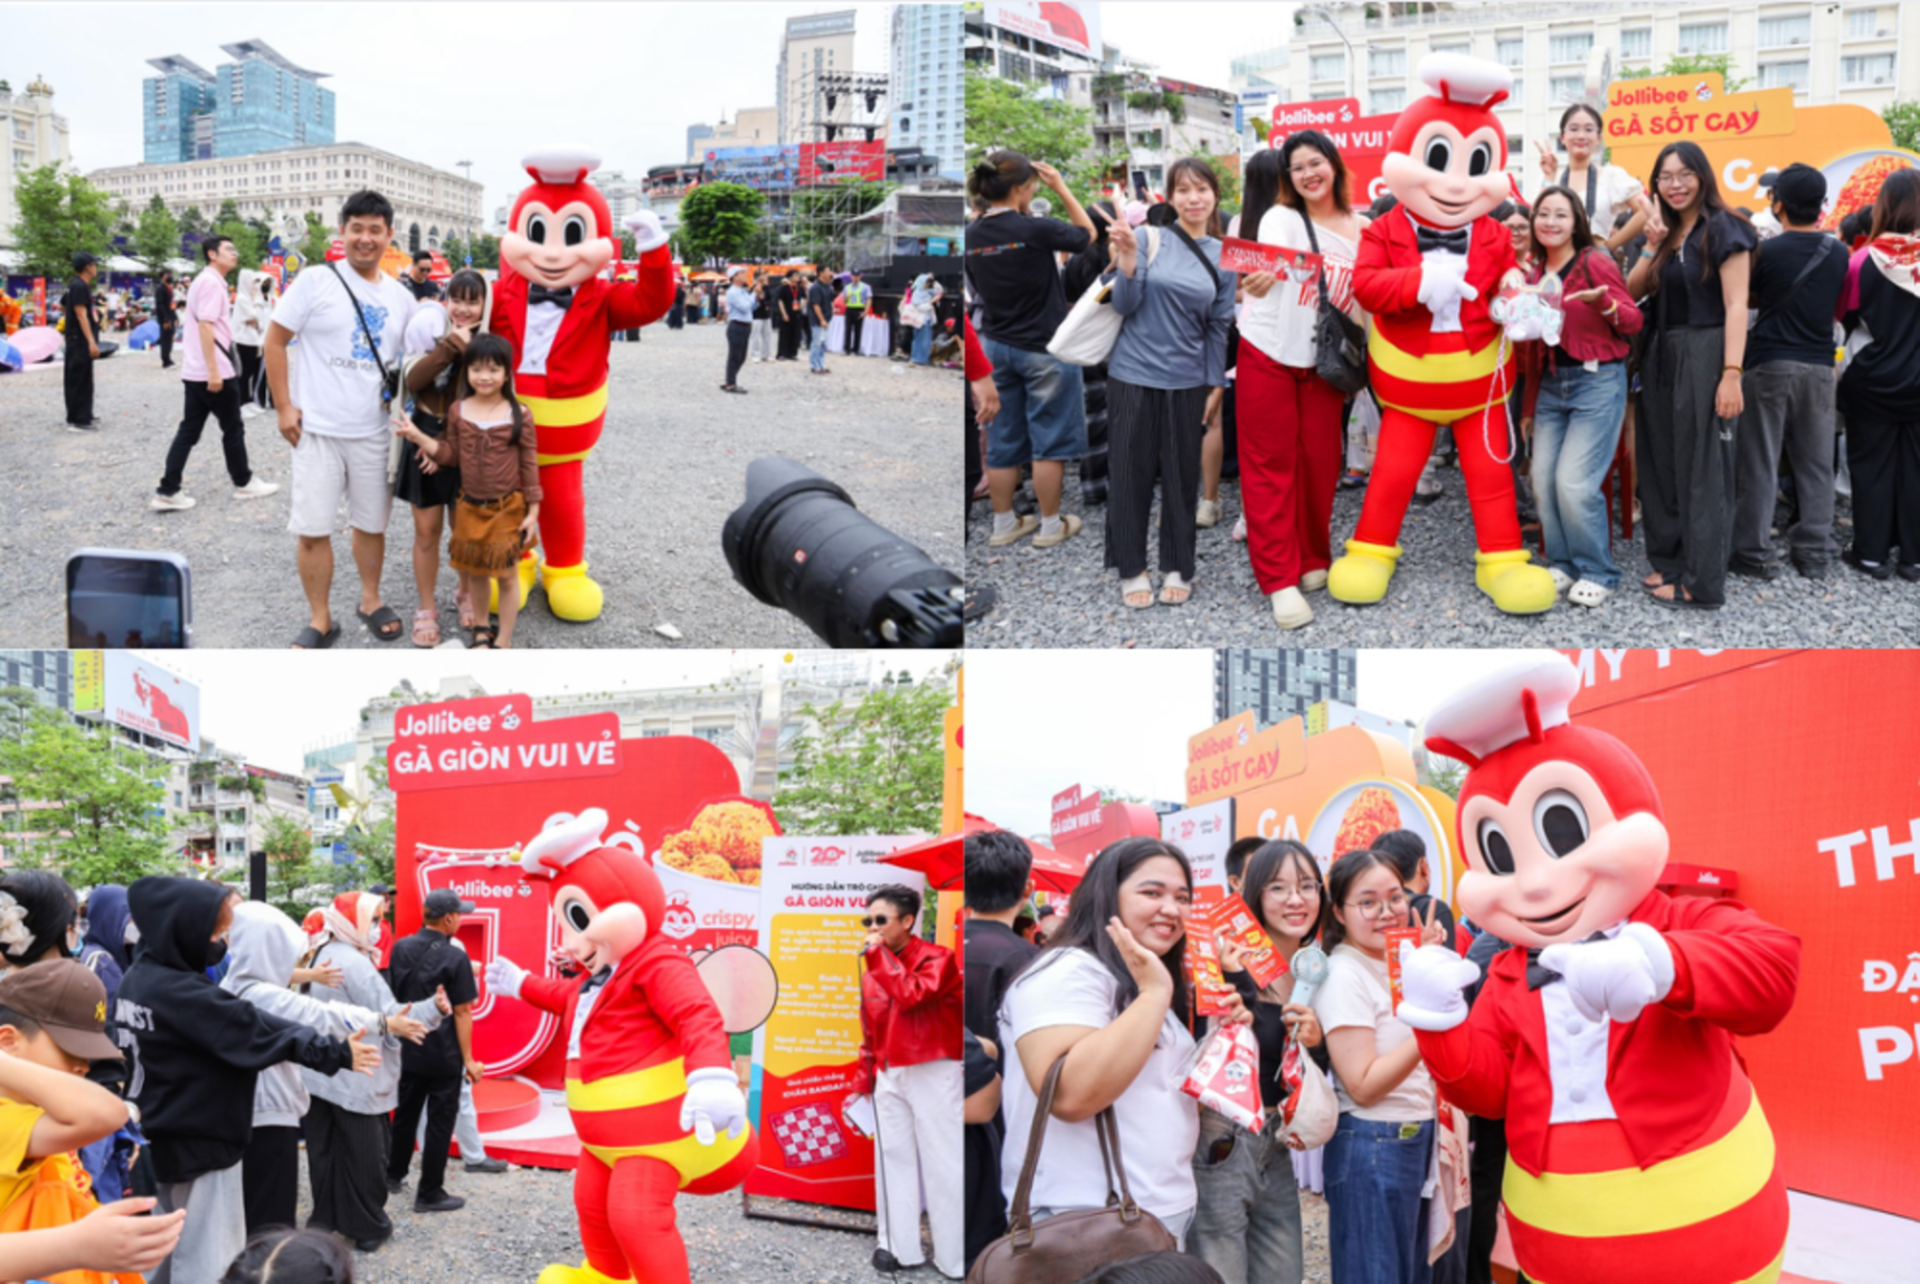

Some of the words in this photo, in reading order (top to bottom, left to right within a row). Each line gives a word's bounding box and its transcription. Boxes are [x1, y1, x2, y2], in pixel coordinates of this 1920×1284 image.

[1610, 86, 1690, 107] Jollibee
[1275, 107, 1336, 126] Jollibee
[1608, 113, 1644, 137] GÀ
[1649, 106, 1699, 134] SỐT
[1704, 107, 1760, 135] CAY
[1323, 129, 1347, 149] ÒN
[1352, 131, 1383, 148] VUI
[1367, 176, 1392, 202] G
[398, 709, 492, 737] Jollibee
[394, 743, 434, 774] GÀ
[438, 740, 510, 771] GIÒN
[517, 742, 568, 769] VUI
[576, 730, 616, 765] VẺ
[1188, 736, 1234, 764] Jollibee
[1187, 767, 1209, 796] GÀ
[1211, 755, 1241, 790] SỐT
[784, 895, 806, 908] GÀ
[808, 895, 845, 907] GIÒN
[848, 897, 868, 908] VU
[702, 909, 755, 930] crispy
[715, 931, 752, 948] juicy
[1858, 1023, 1920, 1080] P
